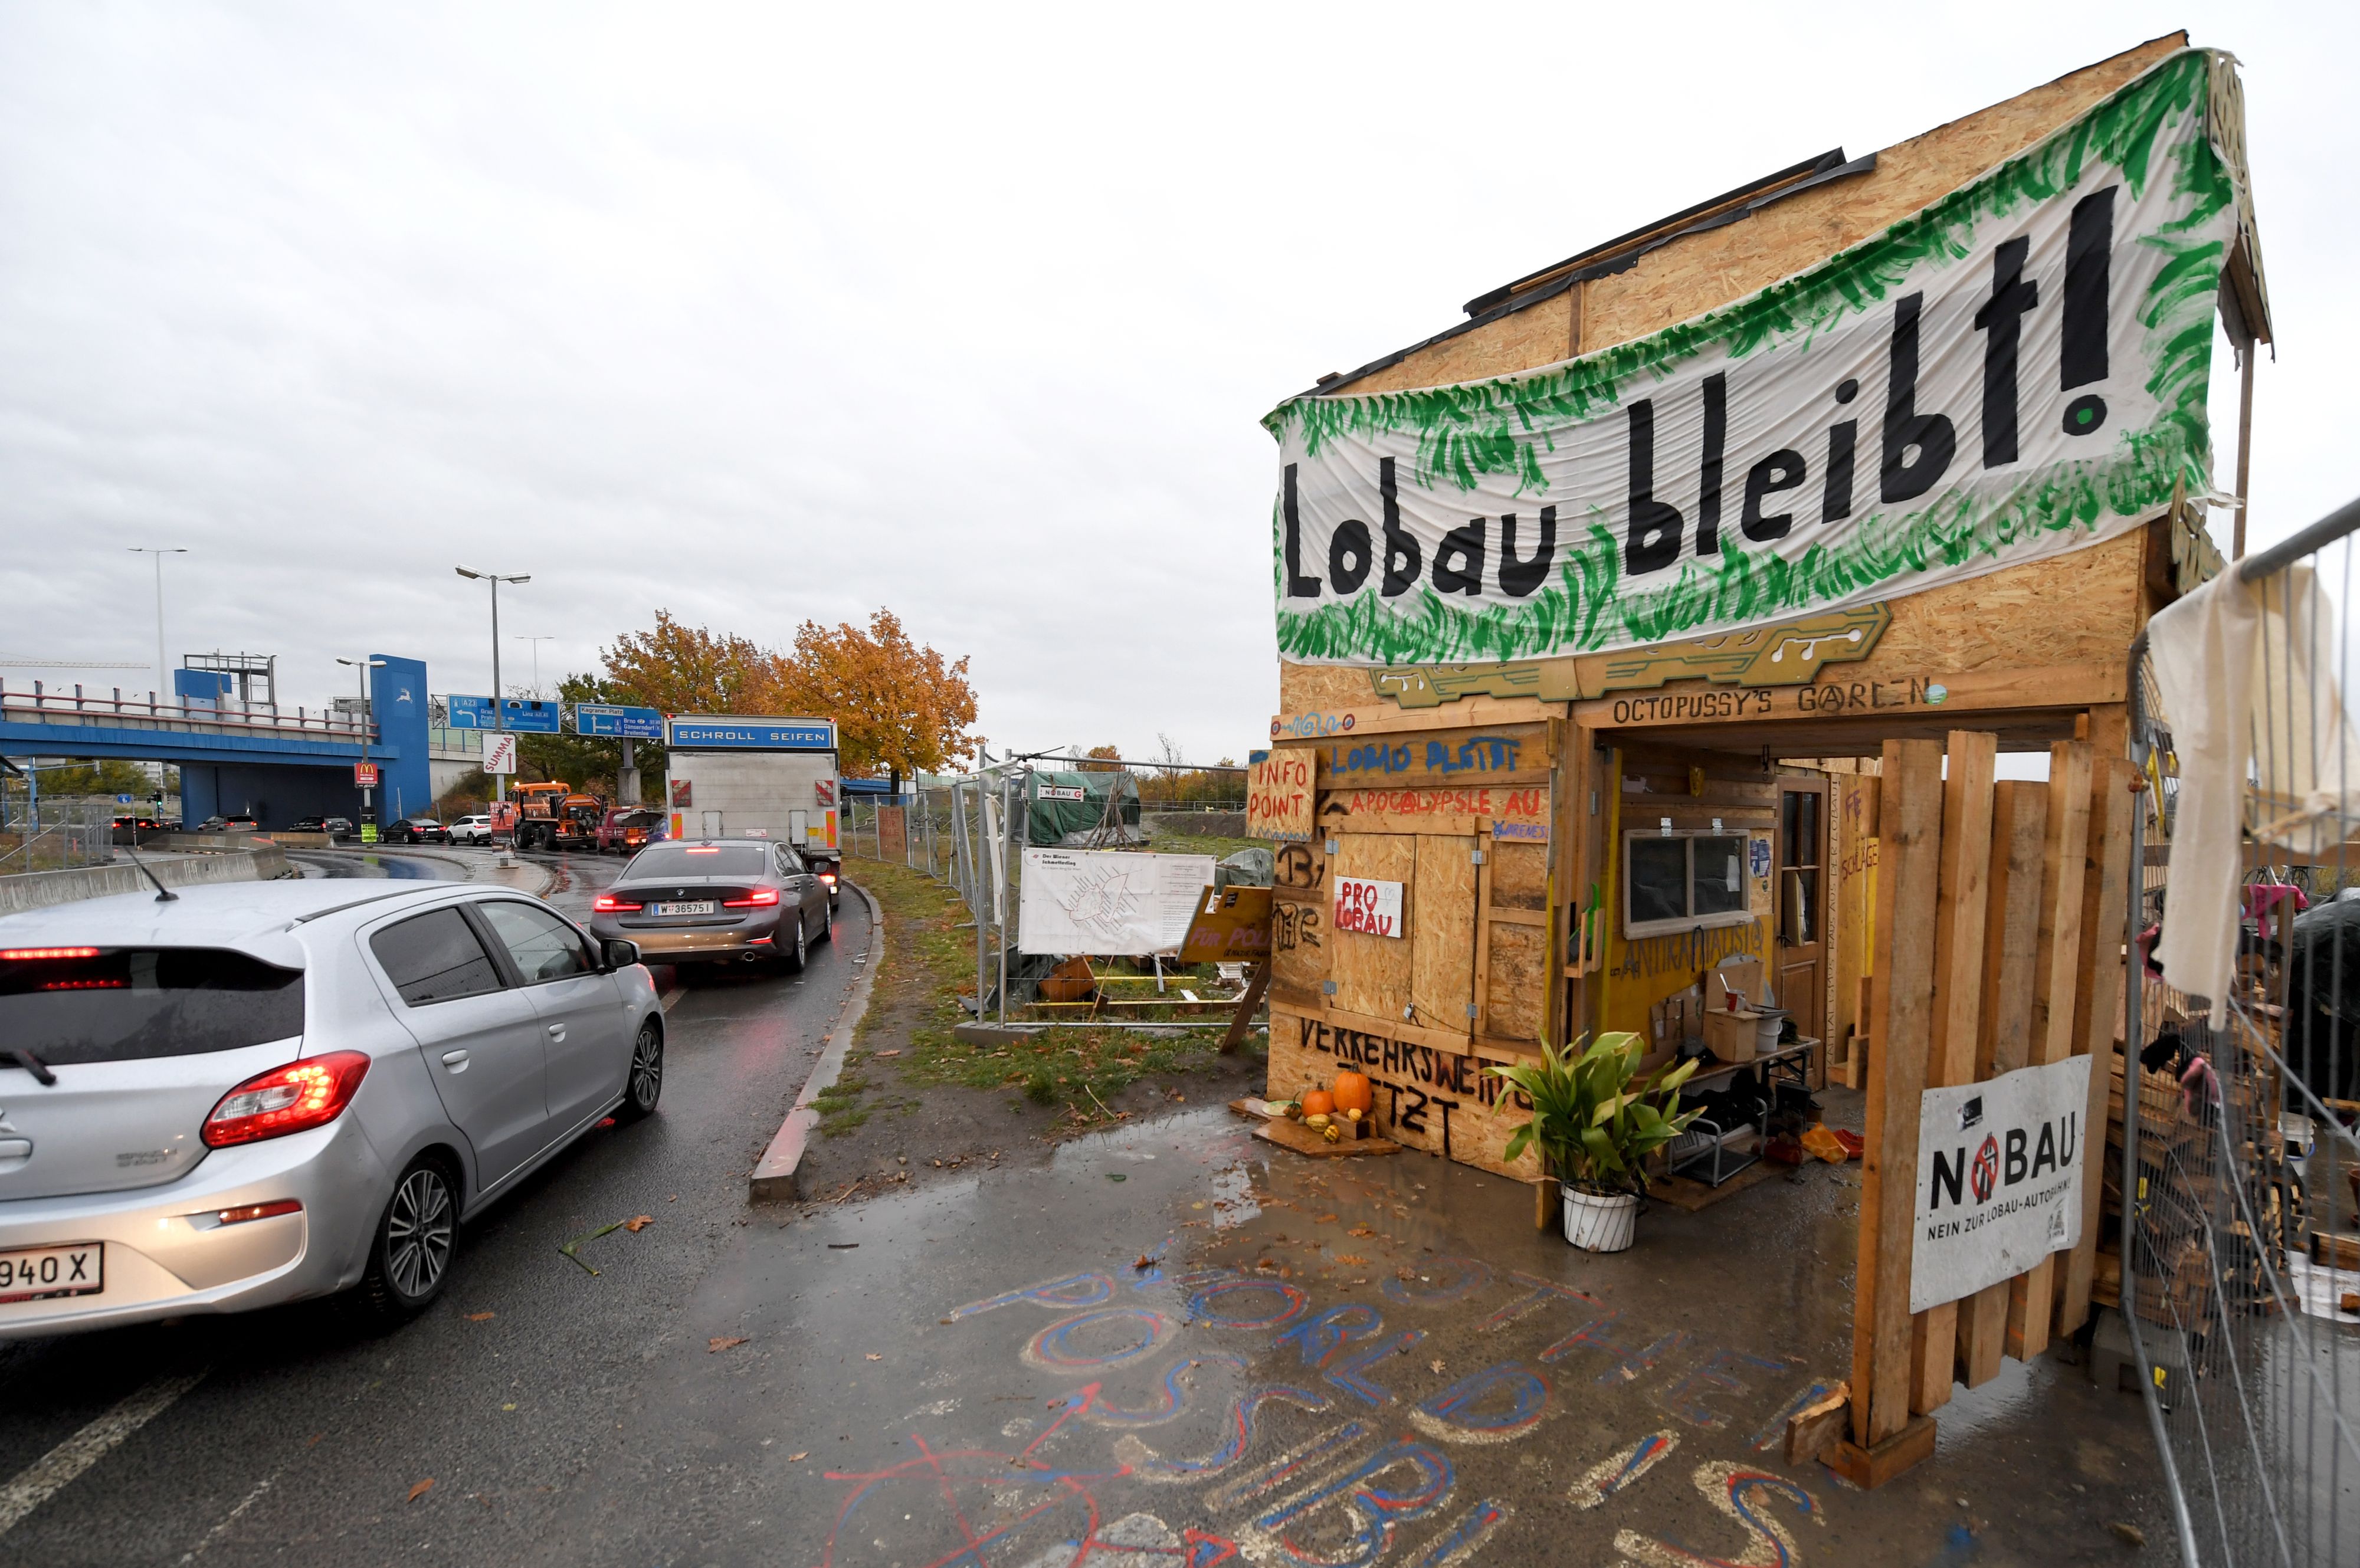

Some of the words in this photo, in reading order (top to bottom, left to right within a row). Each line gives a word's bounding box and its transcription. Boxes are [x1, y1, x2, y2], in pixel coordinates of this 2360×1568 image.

[1283, 455, 1556, 599] Lobau
[1625, 184, 2119, 578] bleibt!
[1614, 688, 1772, 724] OCTOPUSSY'S
[679, 730, 756, 740] SCHROLL
[770, 733, 825, 741] SEIFEN
[485, 737, 514, 772] SUMMA
[1258, 760, 1307, 788] INFO
[1250, 794, 1304, 821] POINT
[1504, 789, 1540, 816] AU
[1831, 780, 1841, 842] LOBAU!
[1342, 882, 1378, 913] PRO
[1335, 900, 1392, 936] LOBAU
[1189, 927, 1221, 947] FÜR
[1928, 1221, 1959, 1241] NEIN
[1964, 1213, 1984, 1232] ZUR
[1987, 1177, 2071, 1223] LOBAU-AUTOBAHN!
[70, 1254, 87, 1281] X
